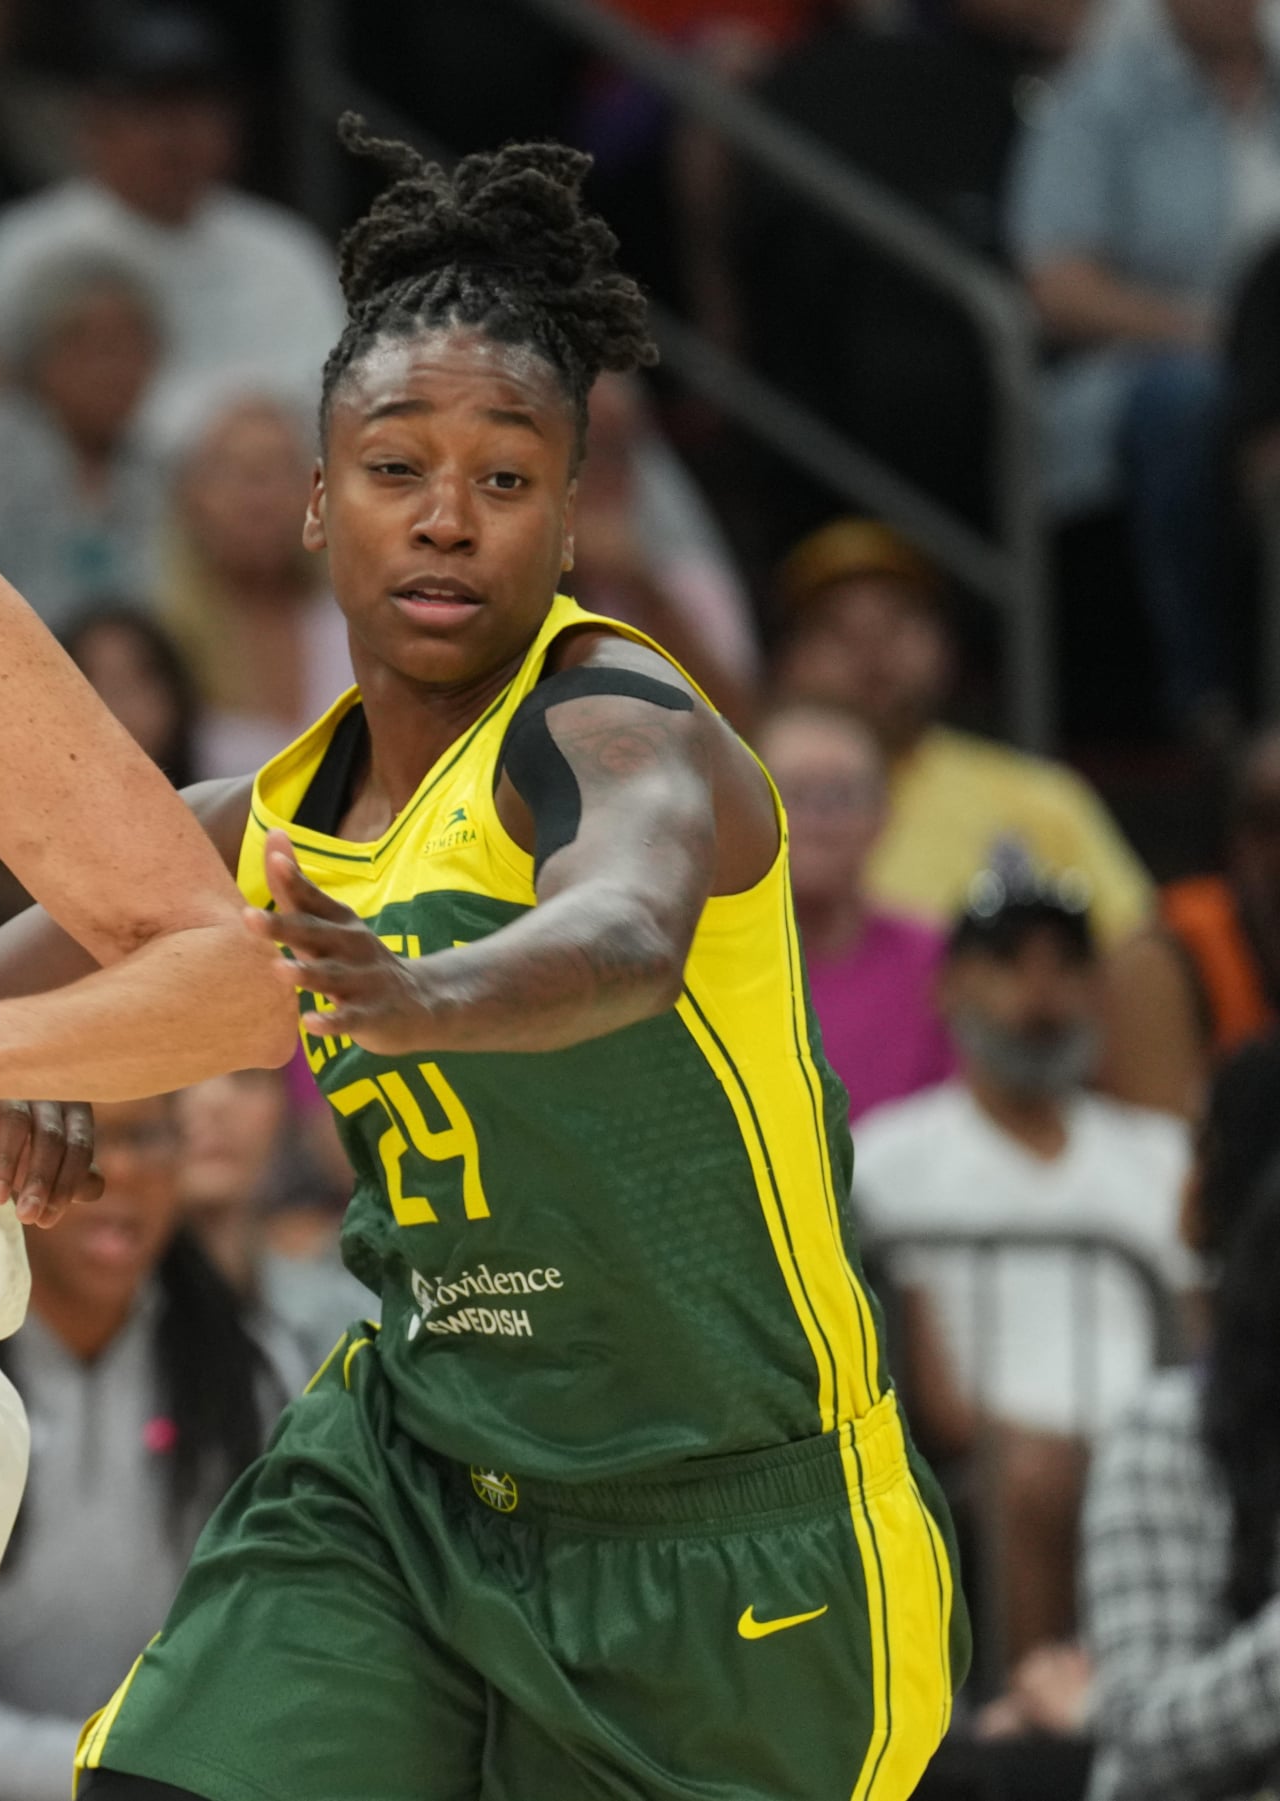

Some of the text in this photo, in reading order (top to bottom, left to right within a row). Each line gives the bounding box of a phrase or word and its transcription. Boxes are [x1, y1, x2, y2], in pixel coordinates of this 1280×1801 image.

[424, 829, 477, 854] SYMETRA
[327, 1062, 491, 1227] 24
[428, 1264, 564, 1308] ovidence
[425, 1307, 533, 1337] SWEDISH
